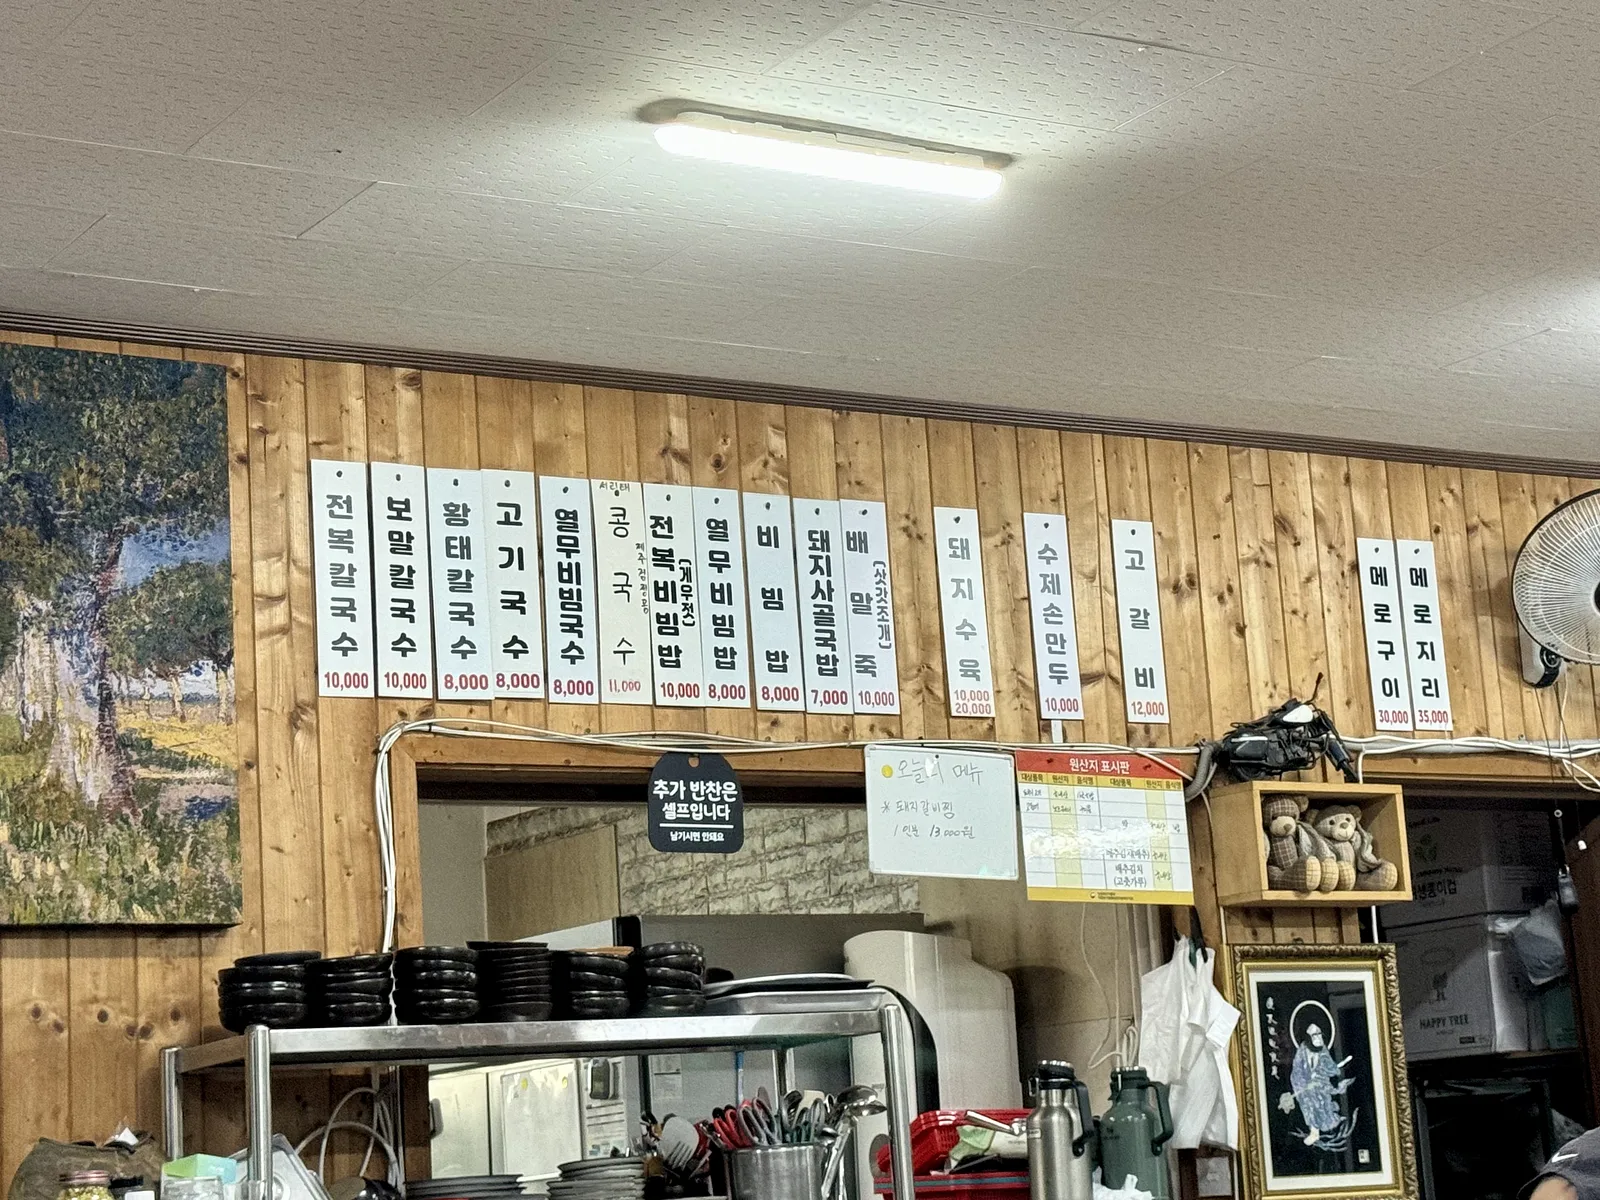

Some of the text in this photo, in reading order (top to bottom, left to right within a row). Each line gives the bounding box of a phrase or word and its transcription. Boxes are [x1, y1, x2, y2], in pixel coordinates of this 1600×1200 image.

[326, 494, 358, 657] 전복칼국수
[386, 496, 417, 657] 보말칼국수
[442, 502, 477, 660] 황태칼국수
[496, 502, 530, 660] 고기국수
[555, 508, 585, 665] 열무비빔국수
[607, 506, 636, 666] 콩국수
[649, 515, 683, 669] 전복비빔밥
[706, 517, 738, 670] 열무비빔밥
[757, 525, 790, 673] 비빔밥
[807, 529, 839, 677] 돼지사골국밥
[845, 530, 877, 678] 배말죽
[948, 537, 981, 682] 돼지수육
[1037, 543, 1069, 685] 수제손만두
[1124, 549, 1155, 689] 고갈비
[1370, 566, 1400, 698] 메로구이
[1409, 567, 1440, 698] 메로지리
[324, 672, 369, 690] 10,000
[384, 672, 427, 690] 10,000
[444, 674, 489, 691] 8,000
[496, 673, 540, 690] 8,000
[553, 679, 594, 697] 8,000
[660, 682, 700, 698] 10,000
[708, 684, 746, 701] 8,000
[761, 686, 799, 702] 8,000
[811, 689, 848, 706] 7,000
[858, 690, 895, 707] 10,000
[954, 689, 990, 702] 10,000
[955, 703, 991, 715] 20,000
[1045, 698, 1079, 714] 10,000
[1131, 701, 1165, 717] 12,000
[1378, 710, 1408, 725] 30,000
[1418, 710, 1448, 725] 35,000
[952, 763, 983, 785] 메뉴
[1069, 758, 1130, 775] 원산지 표시판
[652, 779, 738, 802] 추가 반찬은
[661, 802, 731, 821] 셀프입니다
[670, 831, 700, 842] 남기시면
